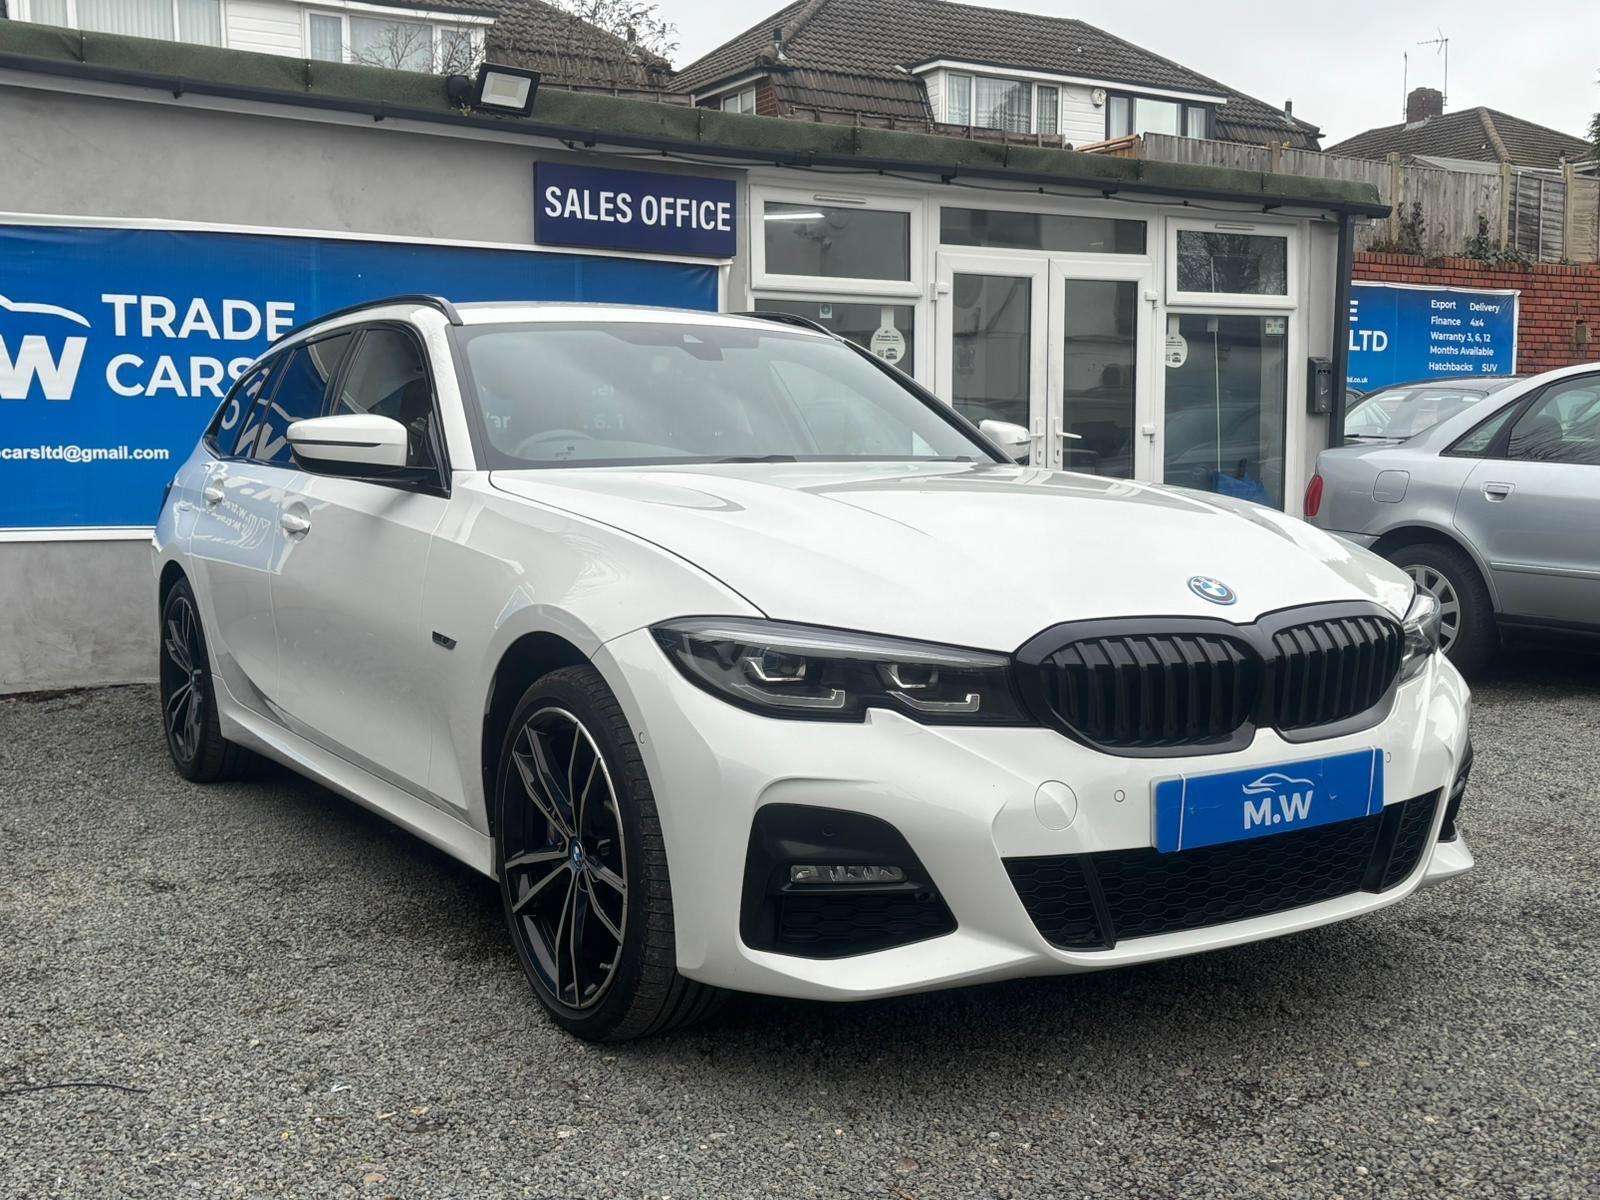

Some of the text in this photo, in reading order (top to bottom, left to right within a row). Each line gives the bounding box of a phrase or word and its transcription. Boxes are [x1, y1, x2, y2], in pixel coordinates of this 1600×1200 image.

[544, 186, 731, 231] SALES OFFICE
[1431, 299, 1500, 314] Export Delivery
[101, 293, 295, 342] TRADE
[1430, 315, 1484, 327] Finance 4x4
[1349, 329, 1388, 352] LTD
[1430, 331, 1466, 343] Warranty
[1483, 333, 1491, 343] 12
[1429, 345, 1495, 356] Months Available
[1428, 362, 1498, 372] Hatchbacks SUV
[0, 445, 169, 462] carsltd@gmail.com
[1243, 790, 1313, 830] M.W
